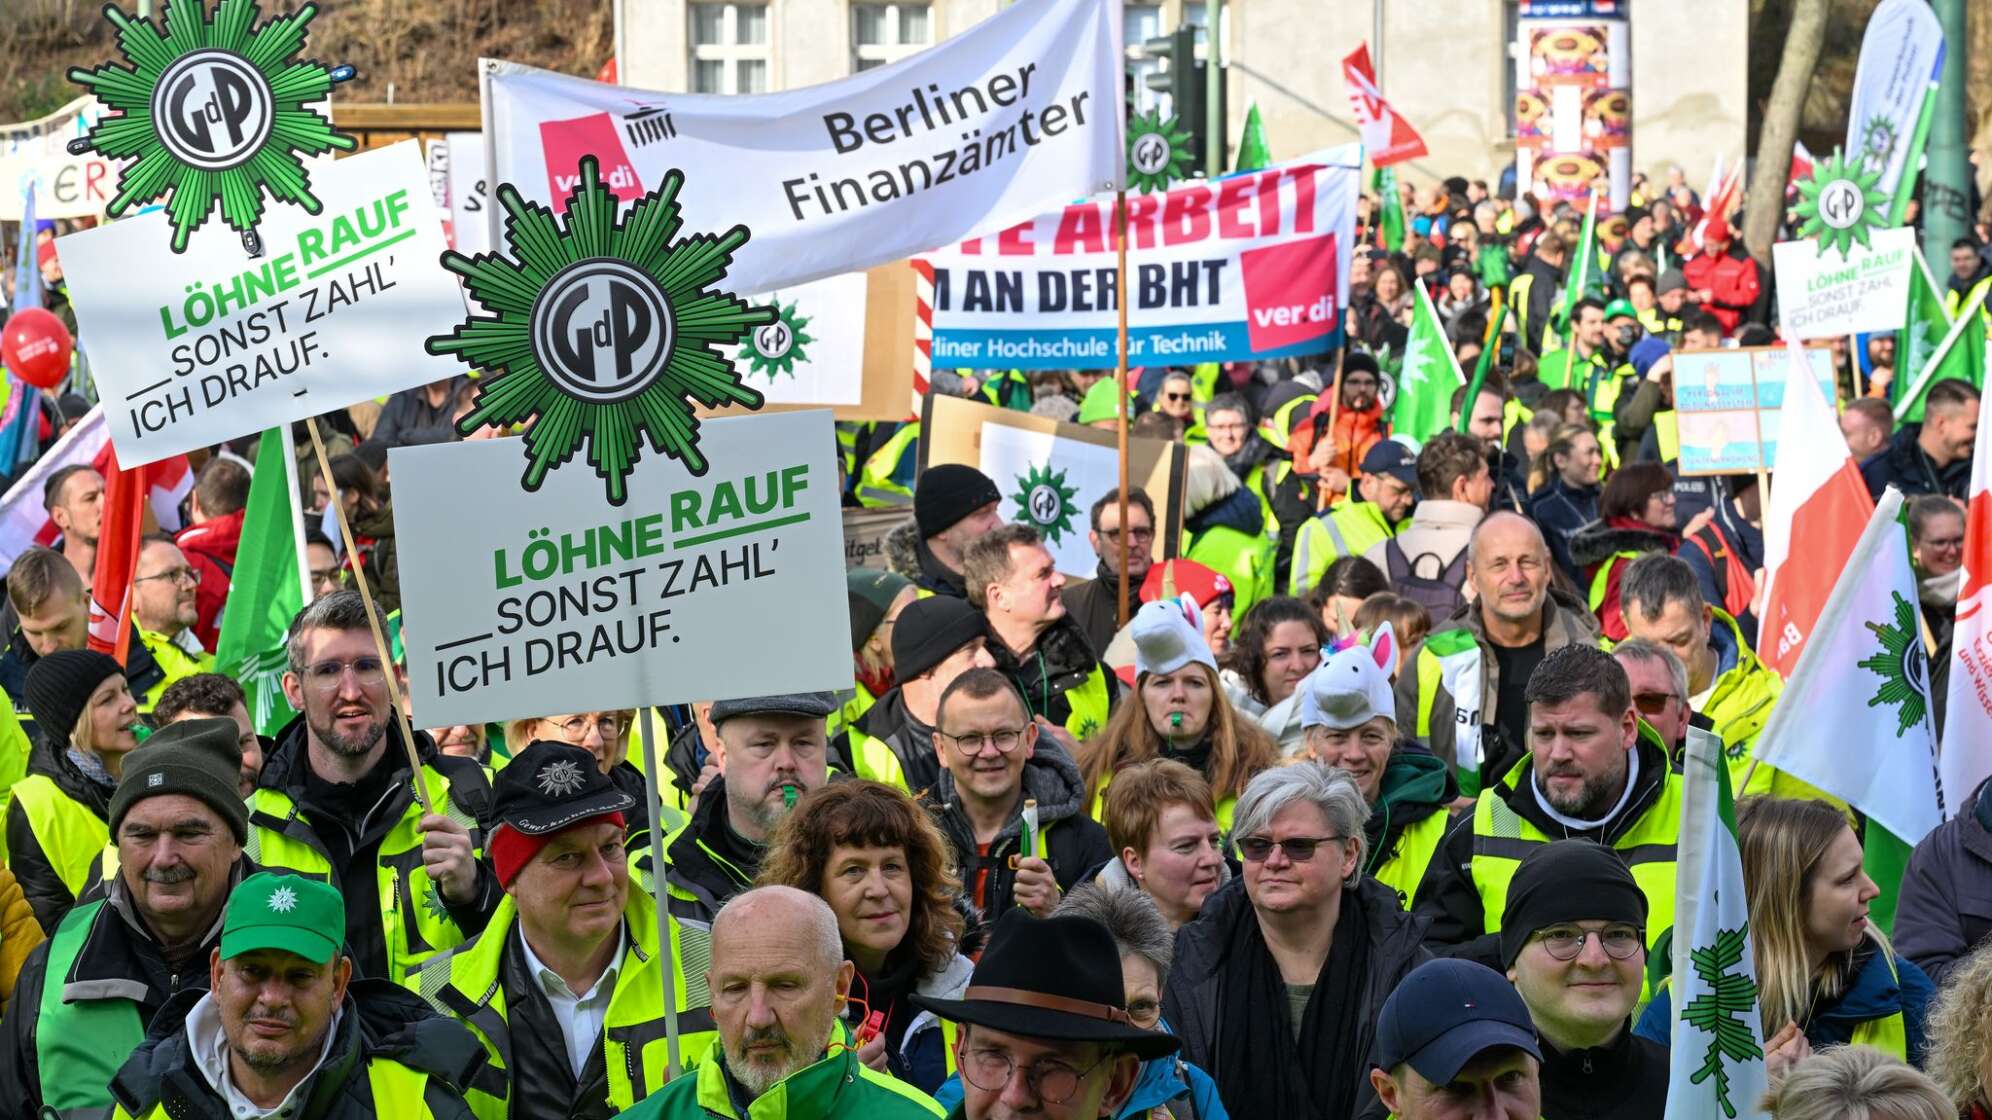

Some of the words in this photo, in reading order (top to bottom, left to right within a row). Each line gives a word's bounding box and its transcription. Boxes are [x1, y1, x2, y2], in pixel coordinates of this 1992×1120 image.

[170, 66, 252, 153] GdP
[823, 62, 1036, 154] Berliner
[782, 91, 1088, 220] Finanzämter
[1053, 164, 1326, 255] ARBEIT
[160, 252, 300, 340] LÖHNE
[297, 189, 409, 265] RAUF
[962, 269, 1024, 313] AN
[1038, 268, 1119, 313] DER
[1138, 258, 1228, 310] BHT
[172, 300, 290, 378] SONST
[552, 279, 652, 382] GdP
[987, 336, 1109, 357] Hochschule
[1150, 330, 1227, 355] Technik
[1254, 295, 1334, 328] ver.di
[130, 387, 194, 438] ICH
[200, 331, 329, 408] DRAUF.
[494, 513, 665, 590] LÖHNE
[670, 464, 810, 533] RAUF
[498, 568, 647, 635] SONST
[436, 646, 510, 697] ICH
[525, 608, 681, 677] DRAUF.
